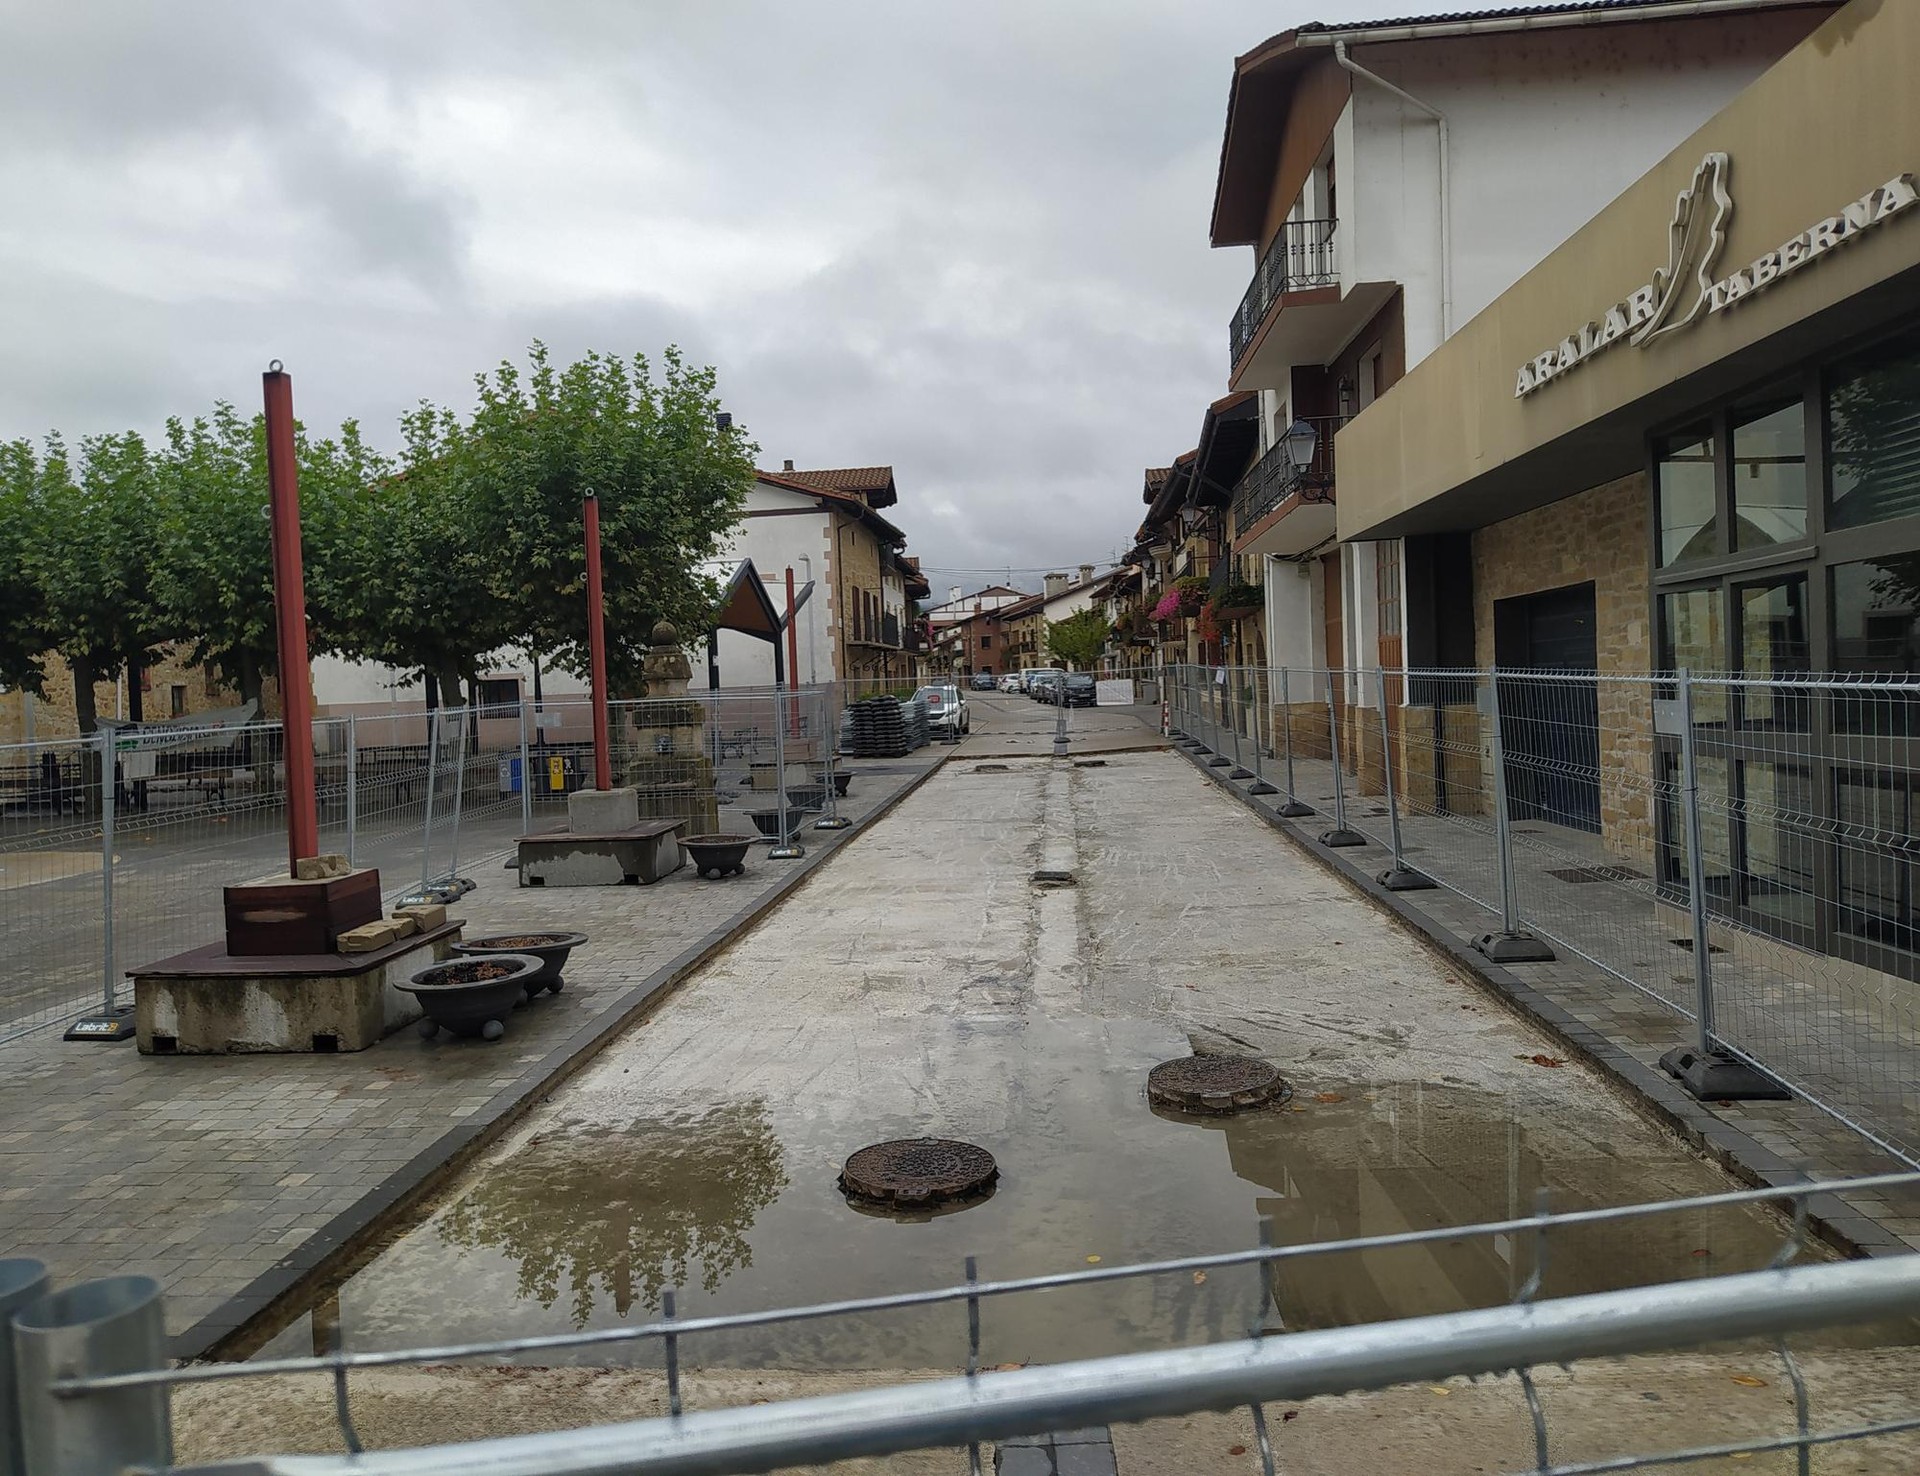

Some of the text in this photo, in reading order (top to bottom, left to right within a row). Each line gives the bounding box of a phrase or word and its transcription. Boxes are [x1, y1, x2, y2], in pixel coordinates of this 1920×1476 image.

[1514, 174, 1920, 398] ARALAR TABERNA
[75, 1022, 110, 1032] Labrit
